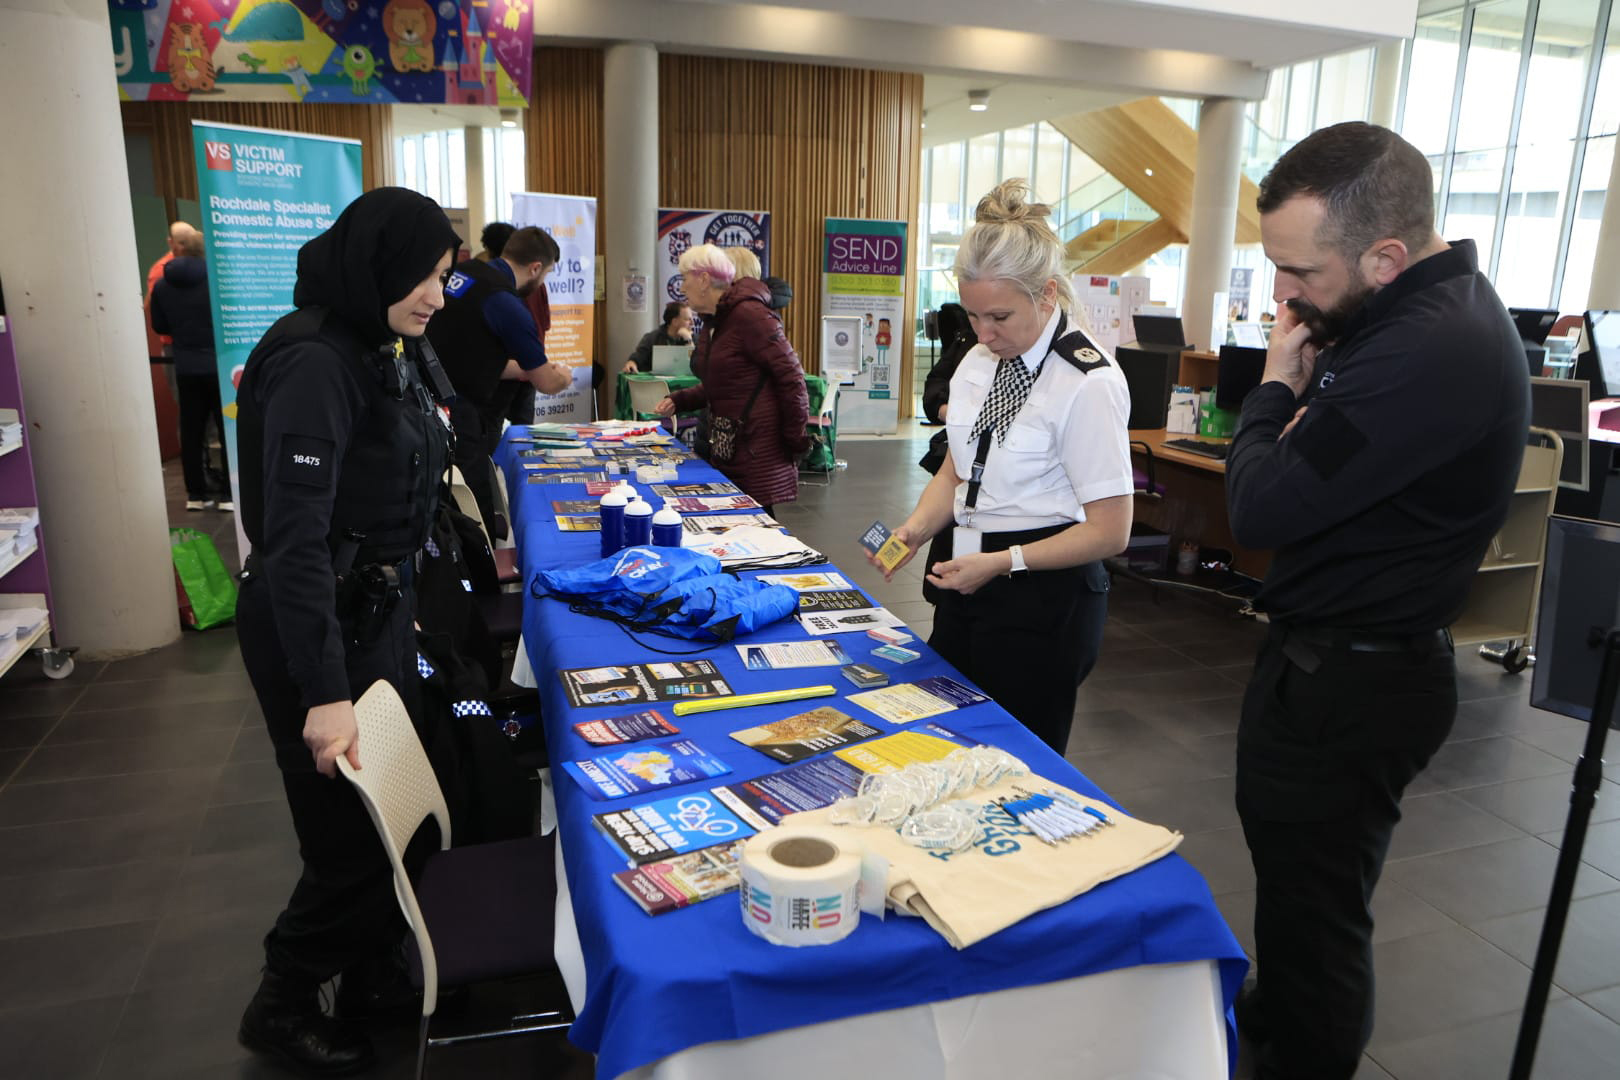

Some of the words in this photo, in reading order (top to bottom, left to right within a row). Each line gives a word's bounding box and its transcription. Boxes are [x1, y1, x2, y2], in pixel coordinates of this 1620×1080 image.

[206, 142, 231, 160] VS
[234, 143, 285, 161] VICTIM
[236, 159, 303, 177] SUPPORT
[209, 195, 271, 212] Rochdale
[273, 200, 331, 215] Specialist
[211, 211, 273, 227] Domestic
[275, 215, 313, 229] Abuse
[709, 219, 724, 236] GET
[724, 213, 761, 236] TOGETHER
[832, 237, 898, 261] SEND
[568, 259, 582, 273] to
[832, 261, 870, 272] Advice
[873, 262, 897, 273] Line
[549, 278, 585, 294] well?
[547, 403, 575, 415] 392210
[293, 454, 320, 466] 18475
[808, 616, 830, 631] FREE
[574, 759, 610, 782] AMNESTY
[601, 811, 638, 837] THEM
[621, 832, 657, 856] STOP
[659, 830, 690, 848] FOR
[751, 887, 772, 924] NO
[813, 894, 842, 929] NO
